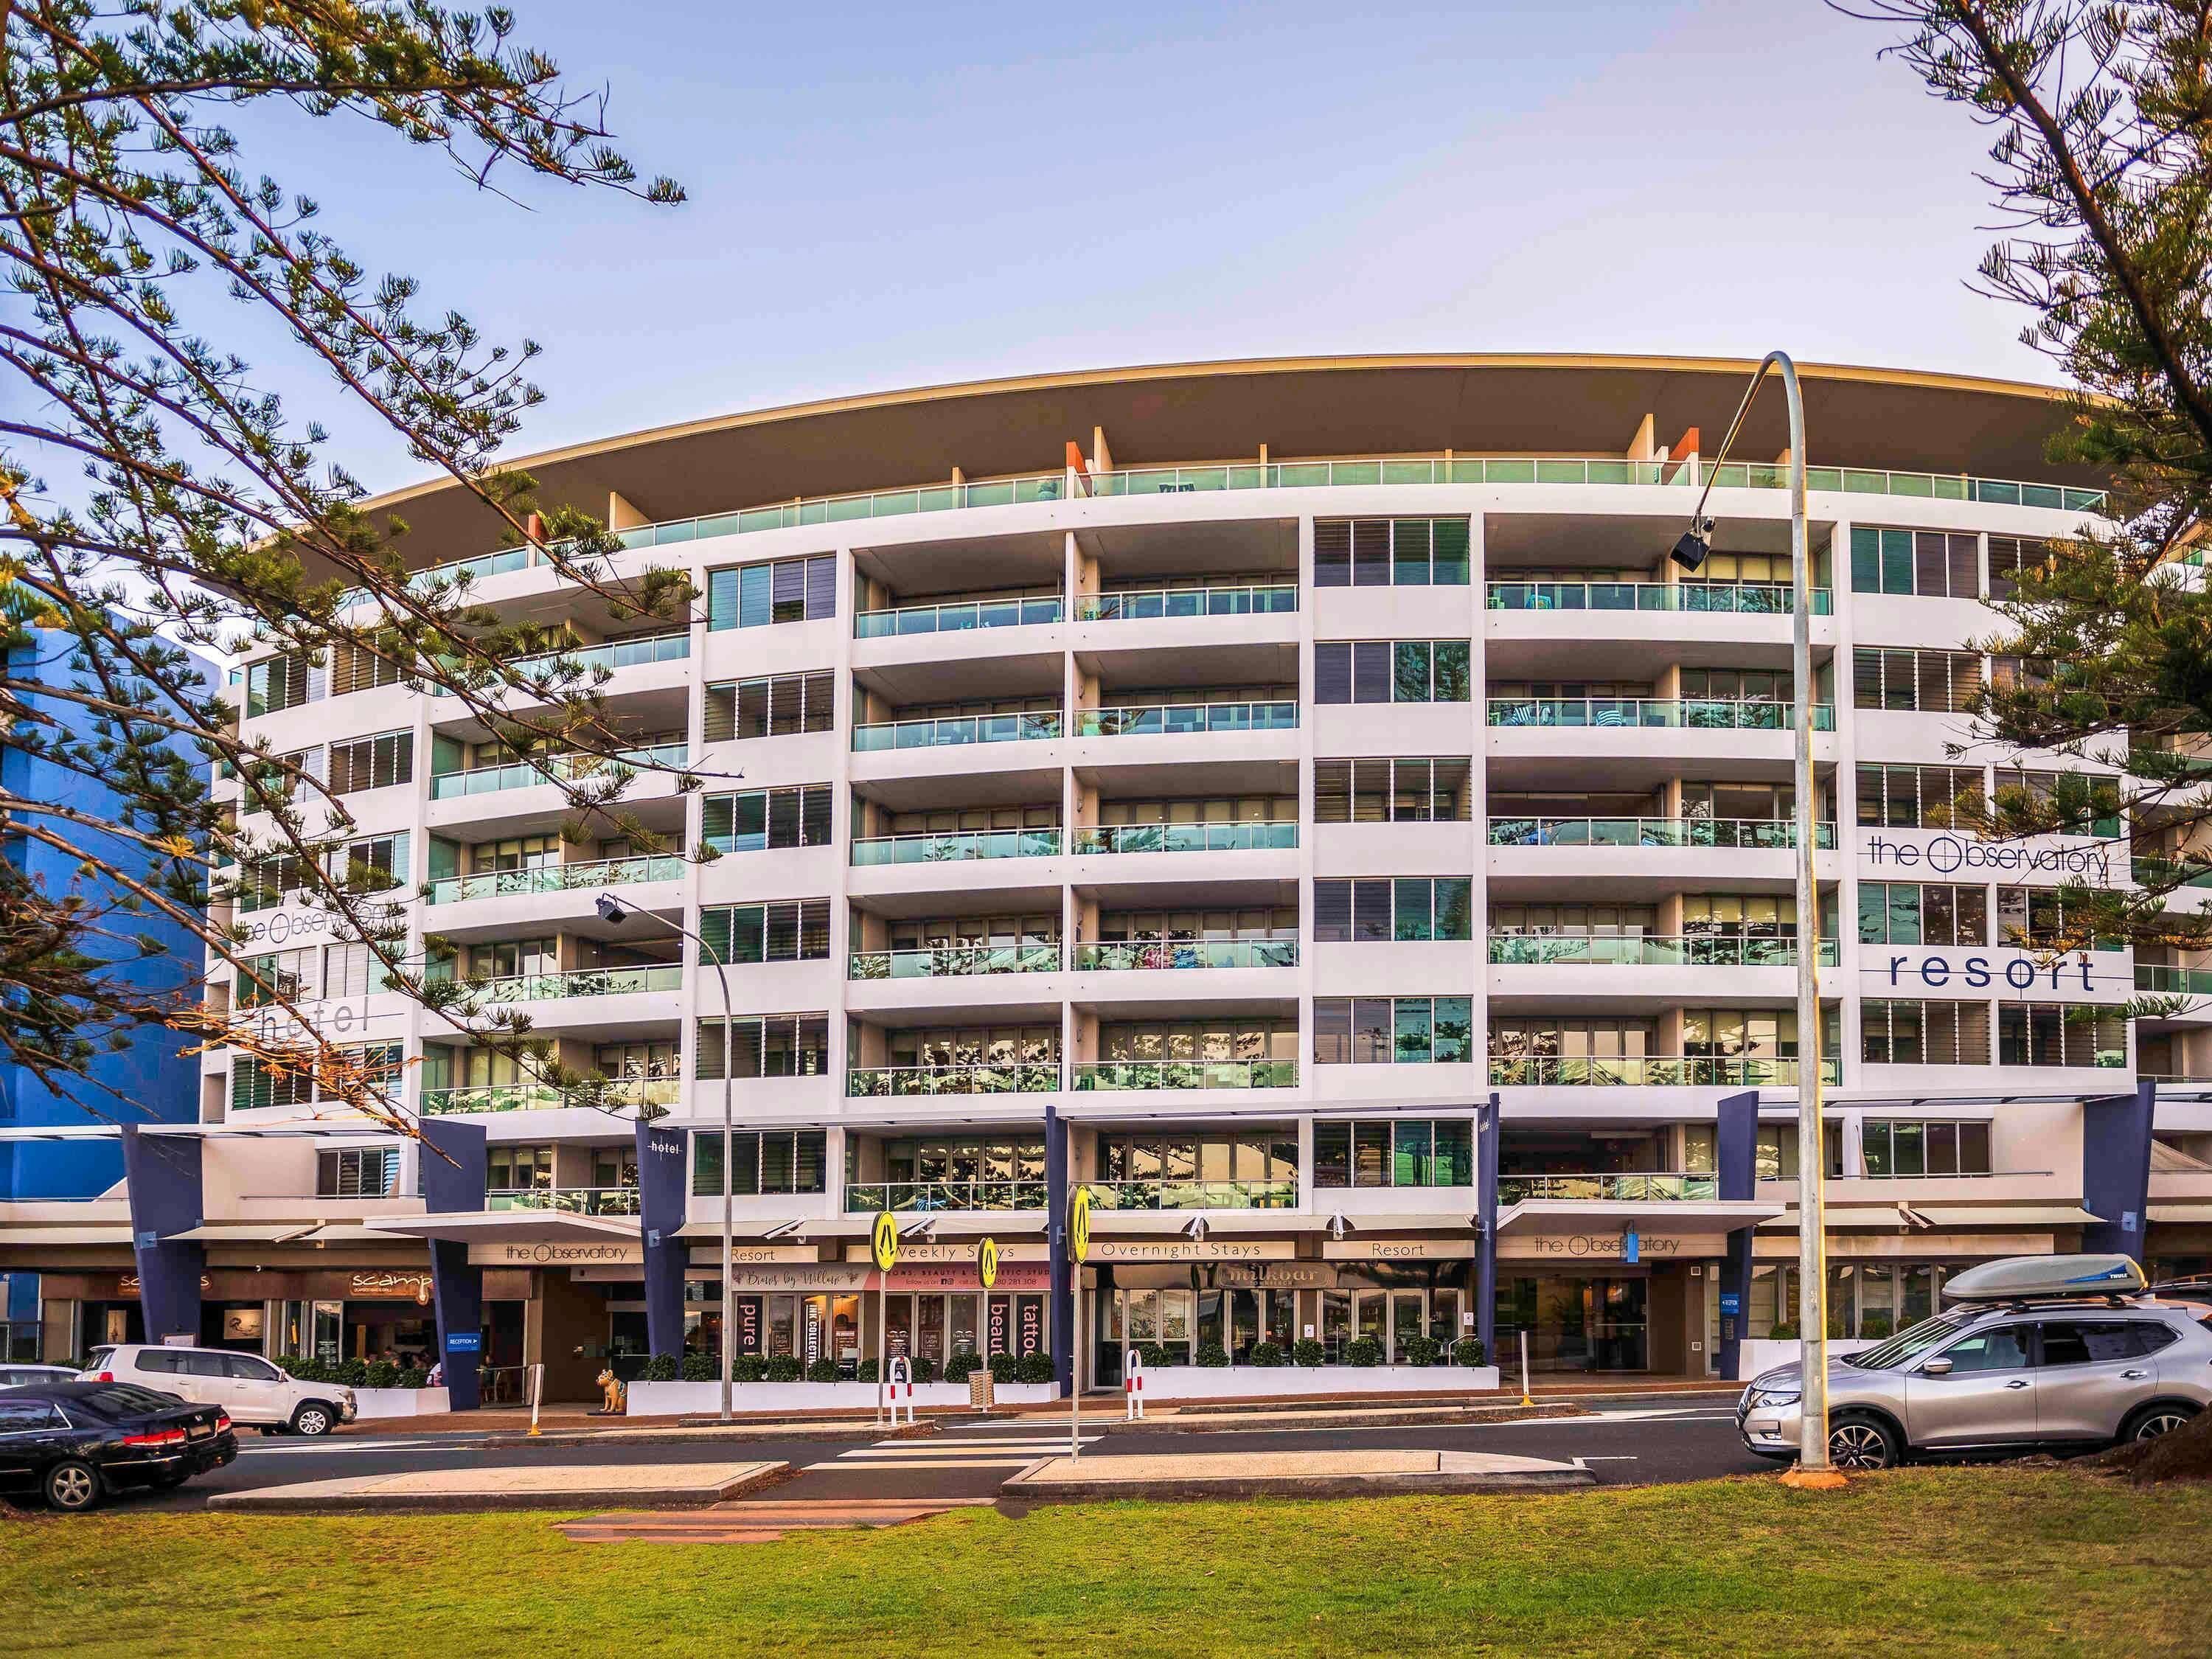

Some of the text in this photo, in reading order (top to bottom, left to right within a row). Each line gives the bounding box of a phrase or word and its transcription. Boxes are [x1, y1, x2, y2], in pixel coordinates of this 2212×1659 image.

[1868, 835, 2110, 880] the Observatory
[270, 904, 389, 944] Observor
[1891, 956, 2094, 992] resort
[262, 996, 369, 1039] hotel
[651, 1141, 679, 1155] hotel
[506, 1244, 627, 1262] the Observatory
[731, 1248, 776, 1262] Resort
[895, 1245, 1015, 1262] Weekly Sys
[1101, 1242, 1261, 1259] Overnight Stays
[1372, 1243, 1425, 1257] Resort
[1534, 1236, 1680, 1256] the Obseatory
[352, 1274, 433, 1301] scamp
[783, 1270, 796, 1289] by
[740, 1304, 756, 1346] pure
[808, 1304, 817, 1368] INK COLLECTIV
[991, 1304, 1008, 1357] beaut
